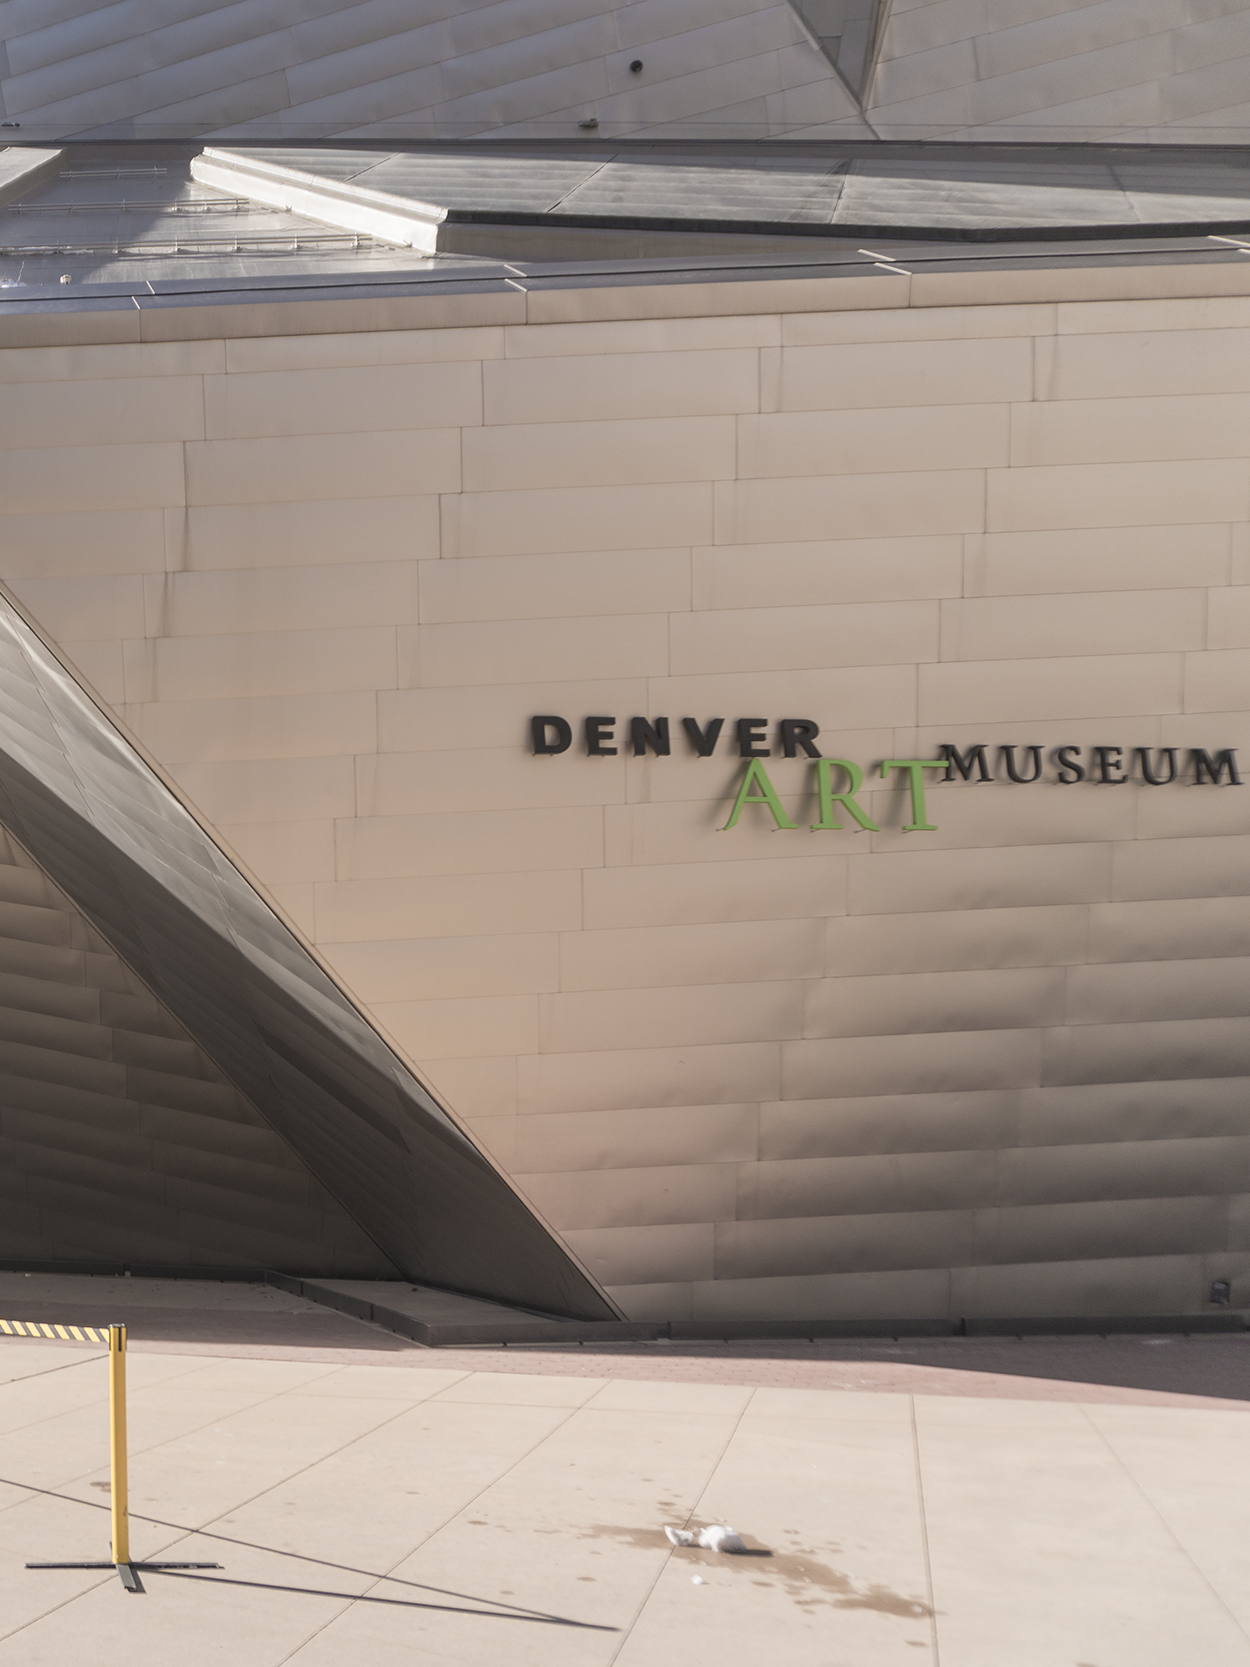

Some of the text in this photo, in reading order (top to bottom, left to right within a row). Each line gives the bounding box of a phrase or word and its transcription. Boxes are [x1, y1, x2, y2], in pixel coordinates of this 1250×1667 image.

[530, 715, 822, 759] DENVER
[722, 744, 1244, 832] ART MUSEUM
